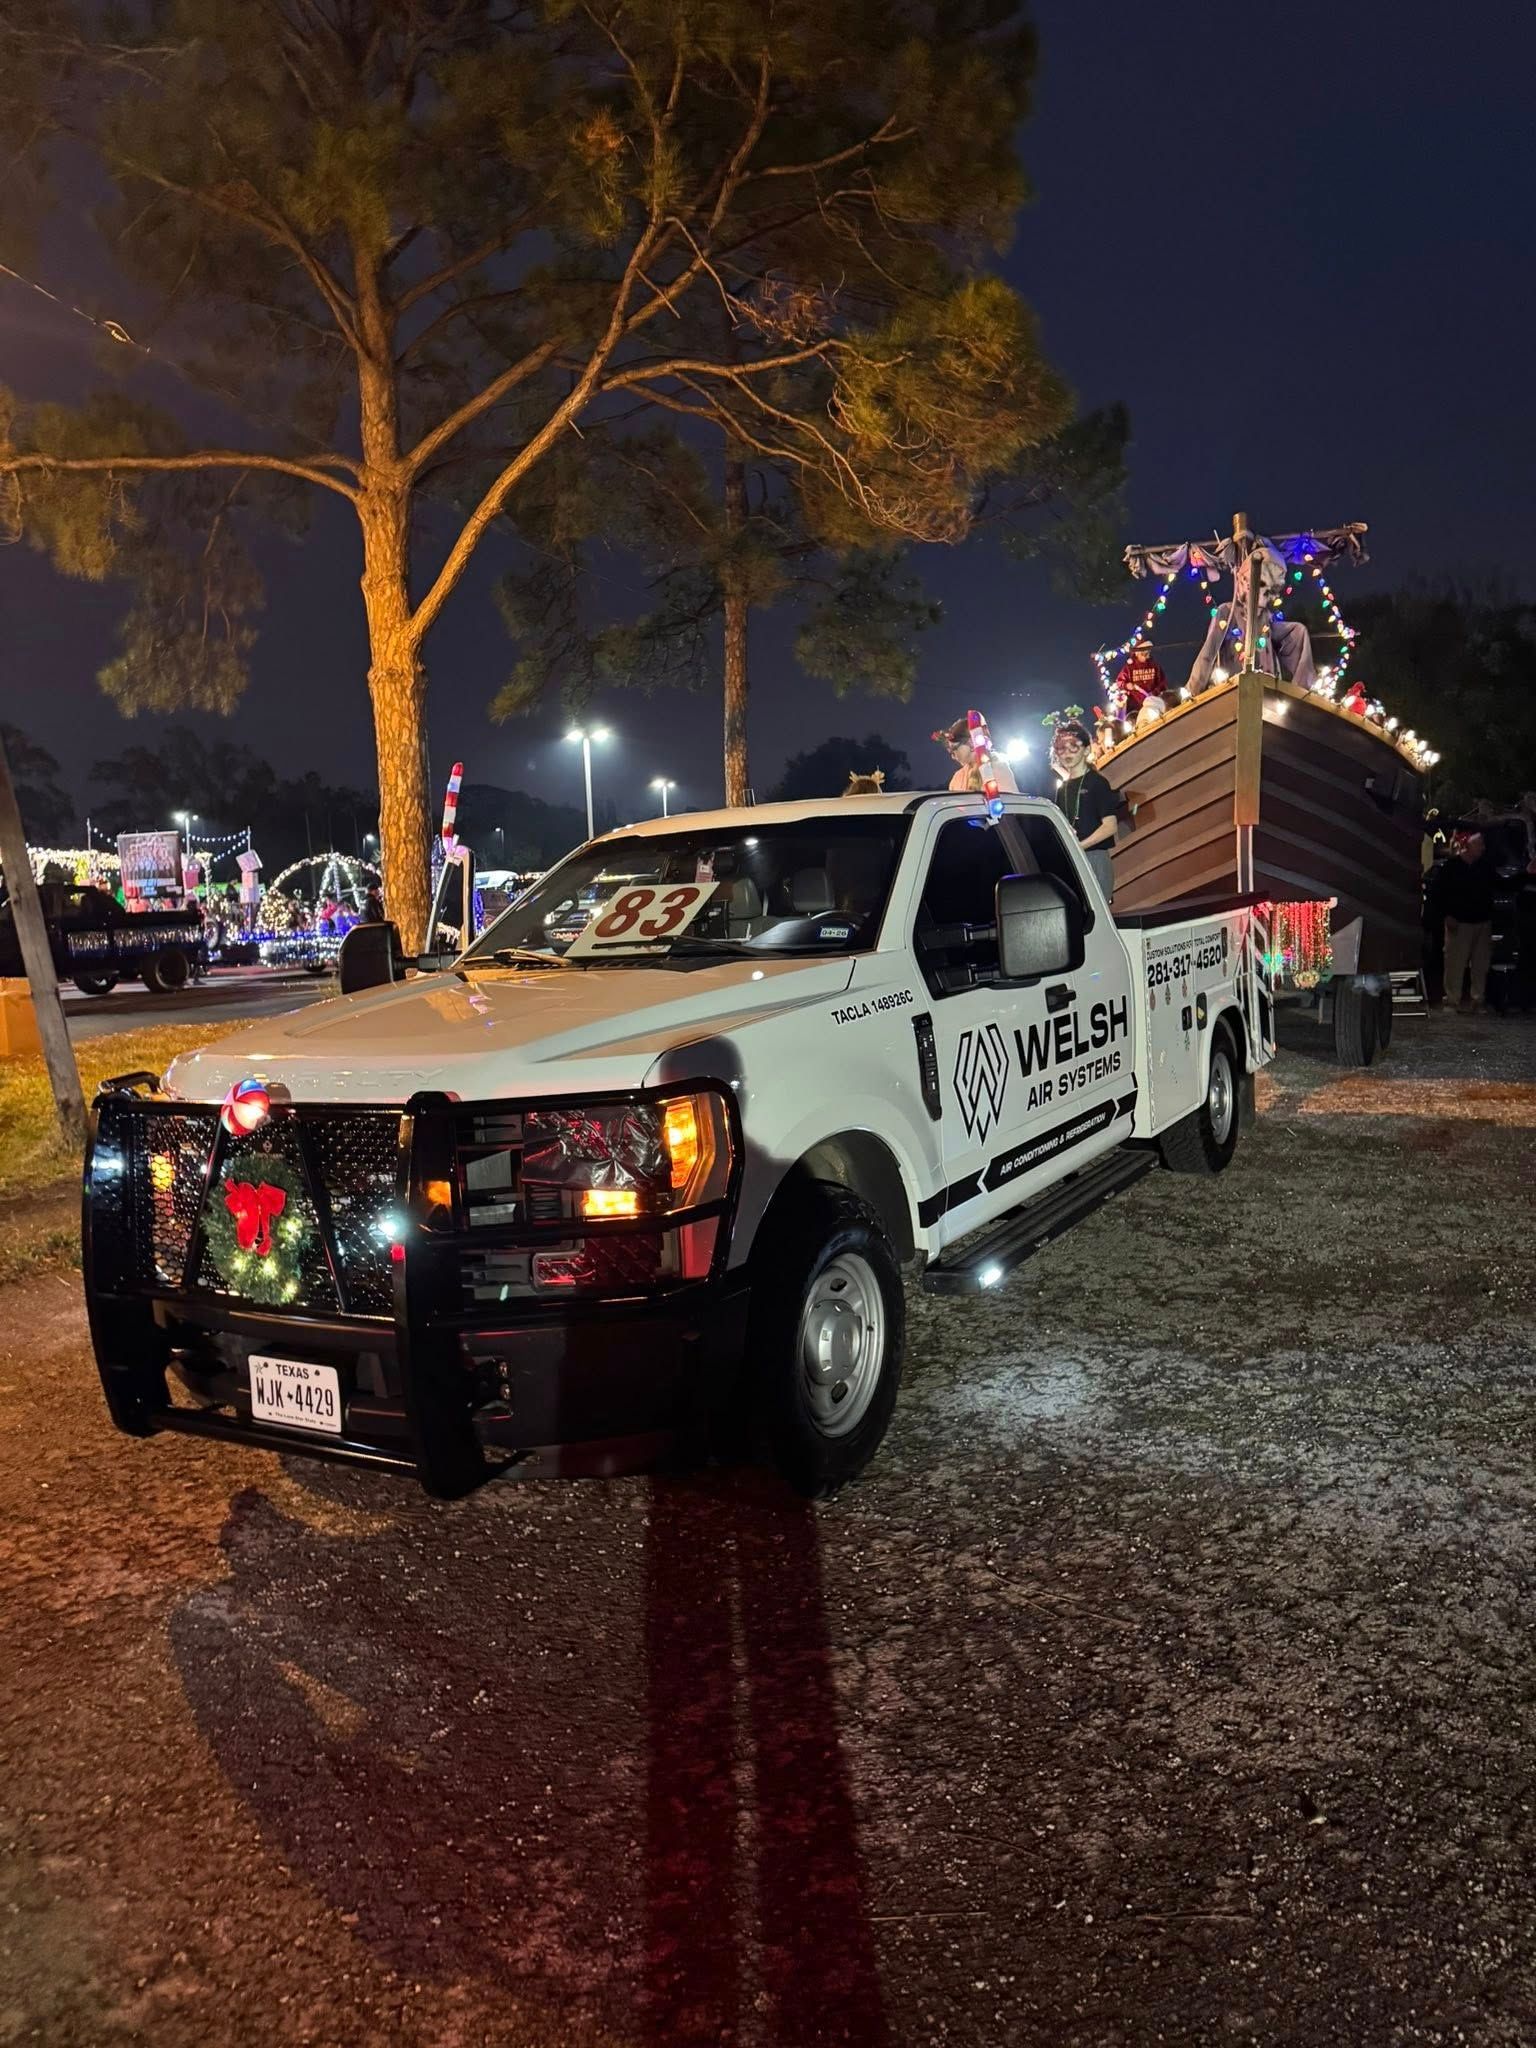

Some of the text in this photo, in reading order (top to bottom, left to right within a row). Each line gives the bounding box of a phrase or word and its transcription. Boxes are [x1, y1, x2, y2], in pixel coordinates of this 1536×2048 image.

[594, 886, 701, 938] 83
[1146, 948, 1164, 960] CUSTOM
[1147, 944, 1221, 988] 281-317-4520
[831, 989, 914, 1025] TACLA 148926C
[1013, 994, 1128, 1078] WELSH
[1026, 1050, 1121, 1111] AIR SYSTEMS
[1000, 1161, 1013, 1176] AIR
[1013, 1137, 1059, 1168] CONDITIONING
[1059, 1134, 1065, 1144] &
[276, 1363, 310, 1380] TEXAS
